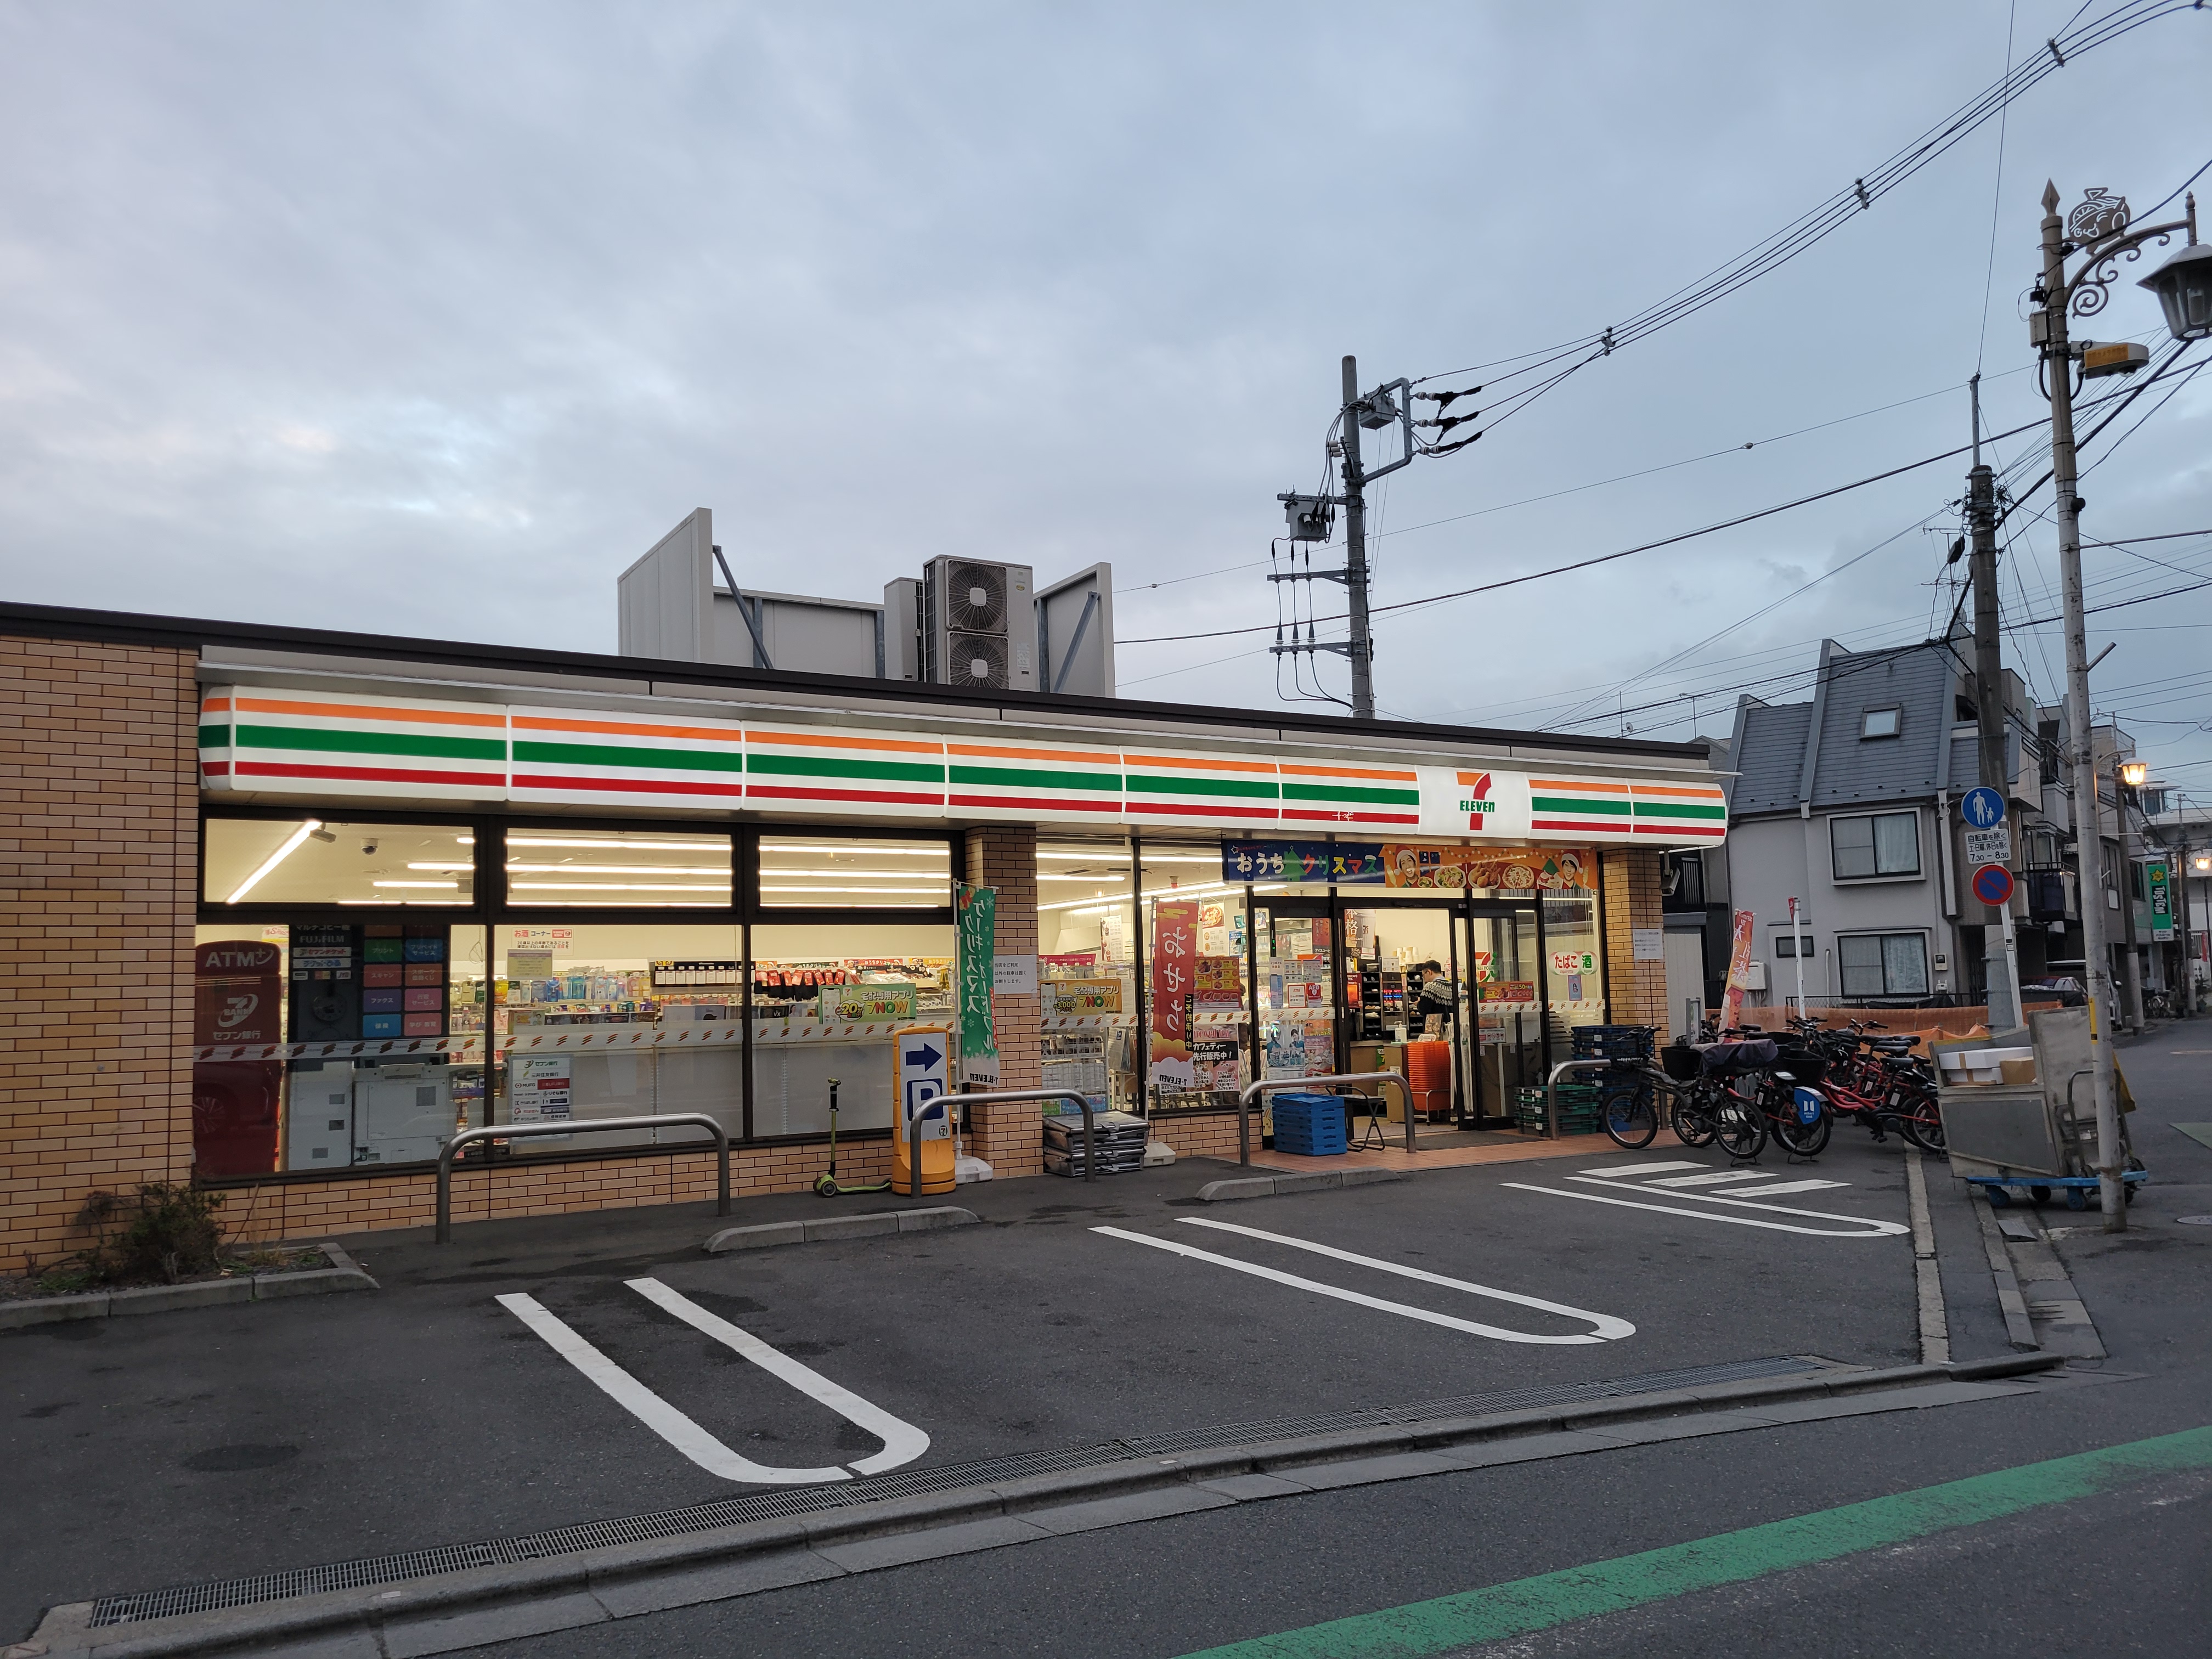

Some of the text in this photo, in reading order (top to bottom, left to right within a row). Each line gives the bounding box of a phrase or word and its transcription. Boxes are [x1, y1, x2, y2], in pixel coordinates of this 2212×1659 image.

[1968, 832, 2006, 843] 自転車を除く
[1555, 955, 1592, 969] たばこ 酒
[861, 990, 914, 1001] 宅配専用アプリ
[1074, 985, 1120, 995] 宅配専用アプリ
[213, 1030, 261, 1040] セブン銀行
[1193, 1042, 1226, 1051] カフェティー
[912, 1081, 941, 1118] P
